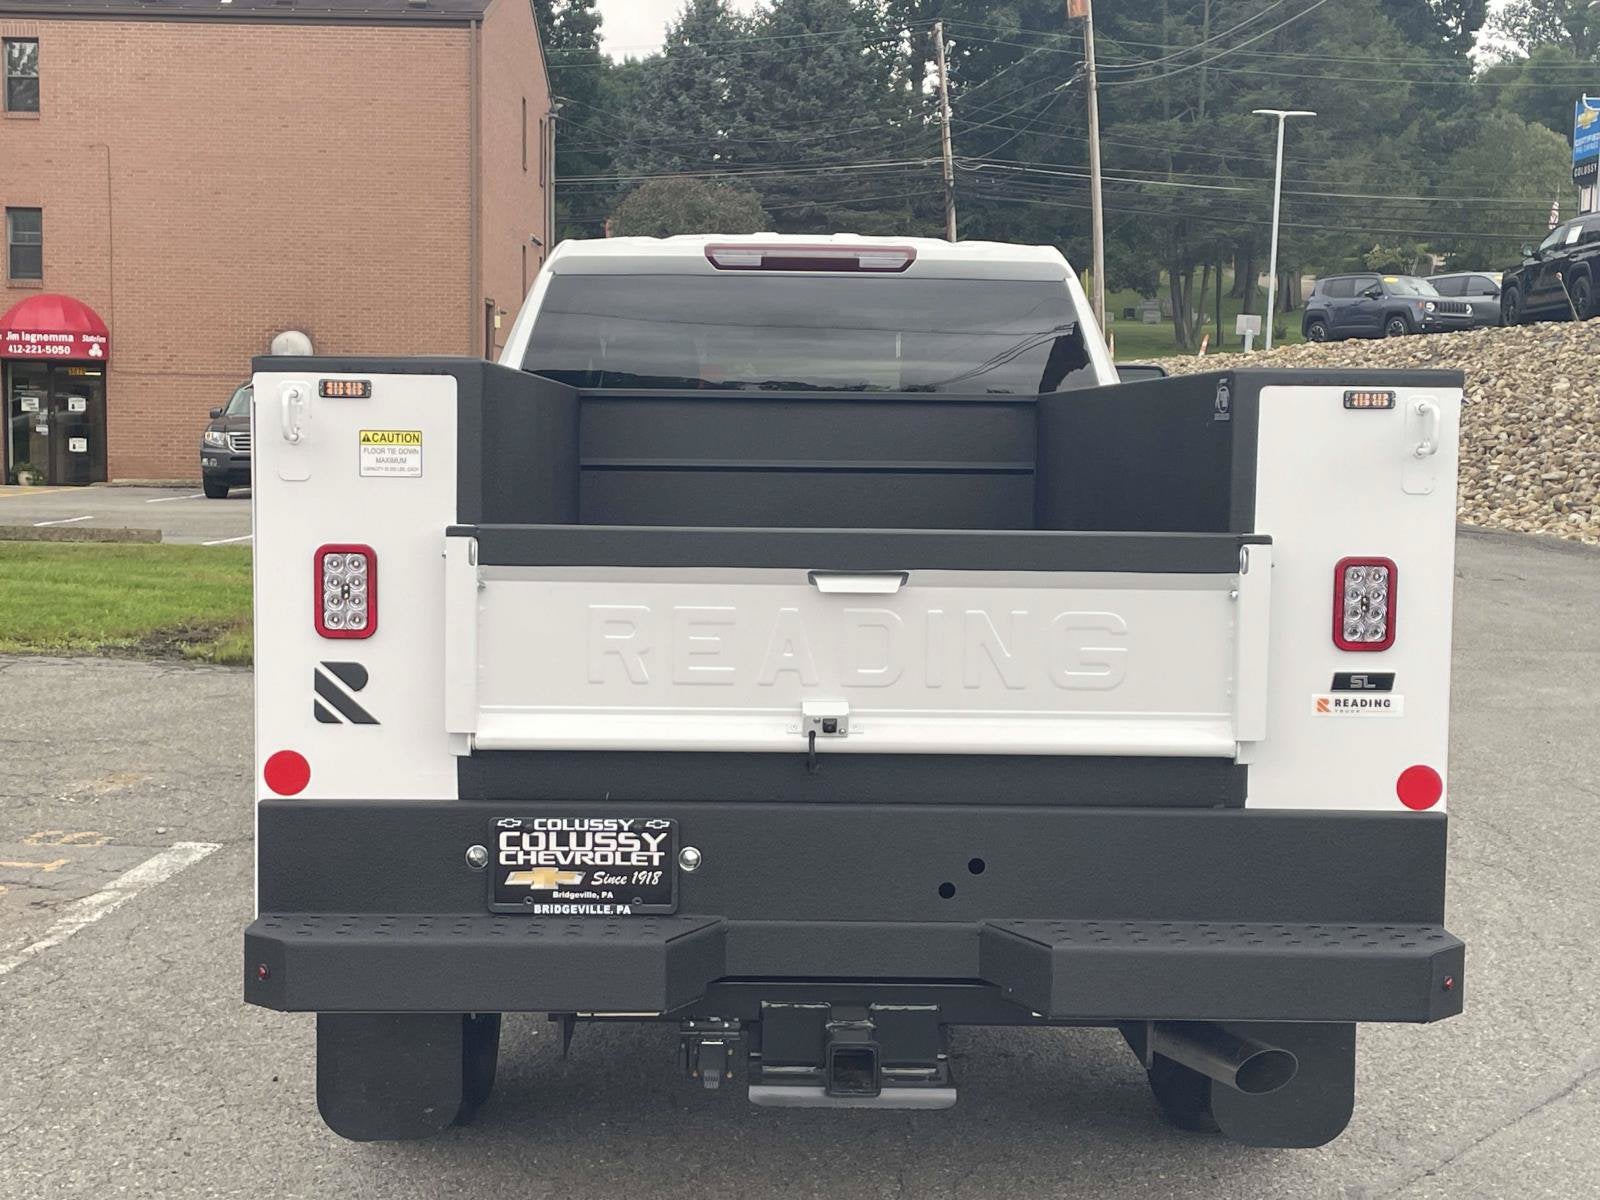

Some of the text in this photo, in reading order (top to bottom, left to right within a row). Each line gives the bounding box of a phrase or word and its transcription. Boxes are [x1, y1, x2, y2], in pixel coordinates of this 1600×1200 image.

[6, 331, 19, 341] Jim
[8, 345, 71, 354] 412-221-5050
[372, 432, 419, 443] CAUTION
[363, 447, 386, 455] FLOOR
[398, 447, 419, 455] DOWN
[587, 605, 1130, 692] READING
[1350, 675, 1376, 688] SL
[1334, 699, 1391, 707] READING
[533, 818, 635, 831] COLUSSY
[499, 831, 668, 852] COLUSSY
[499, 850, 666, 866] CHEVROLET
[591, 870, 662, 886] Since 1918
[552, 891, 614, 899] Bridgeville, PA
[616, 905, 632, 914] PA
